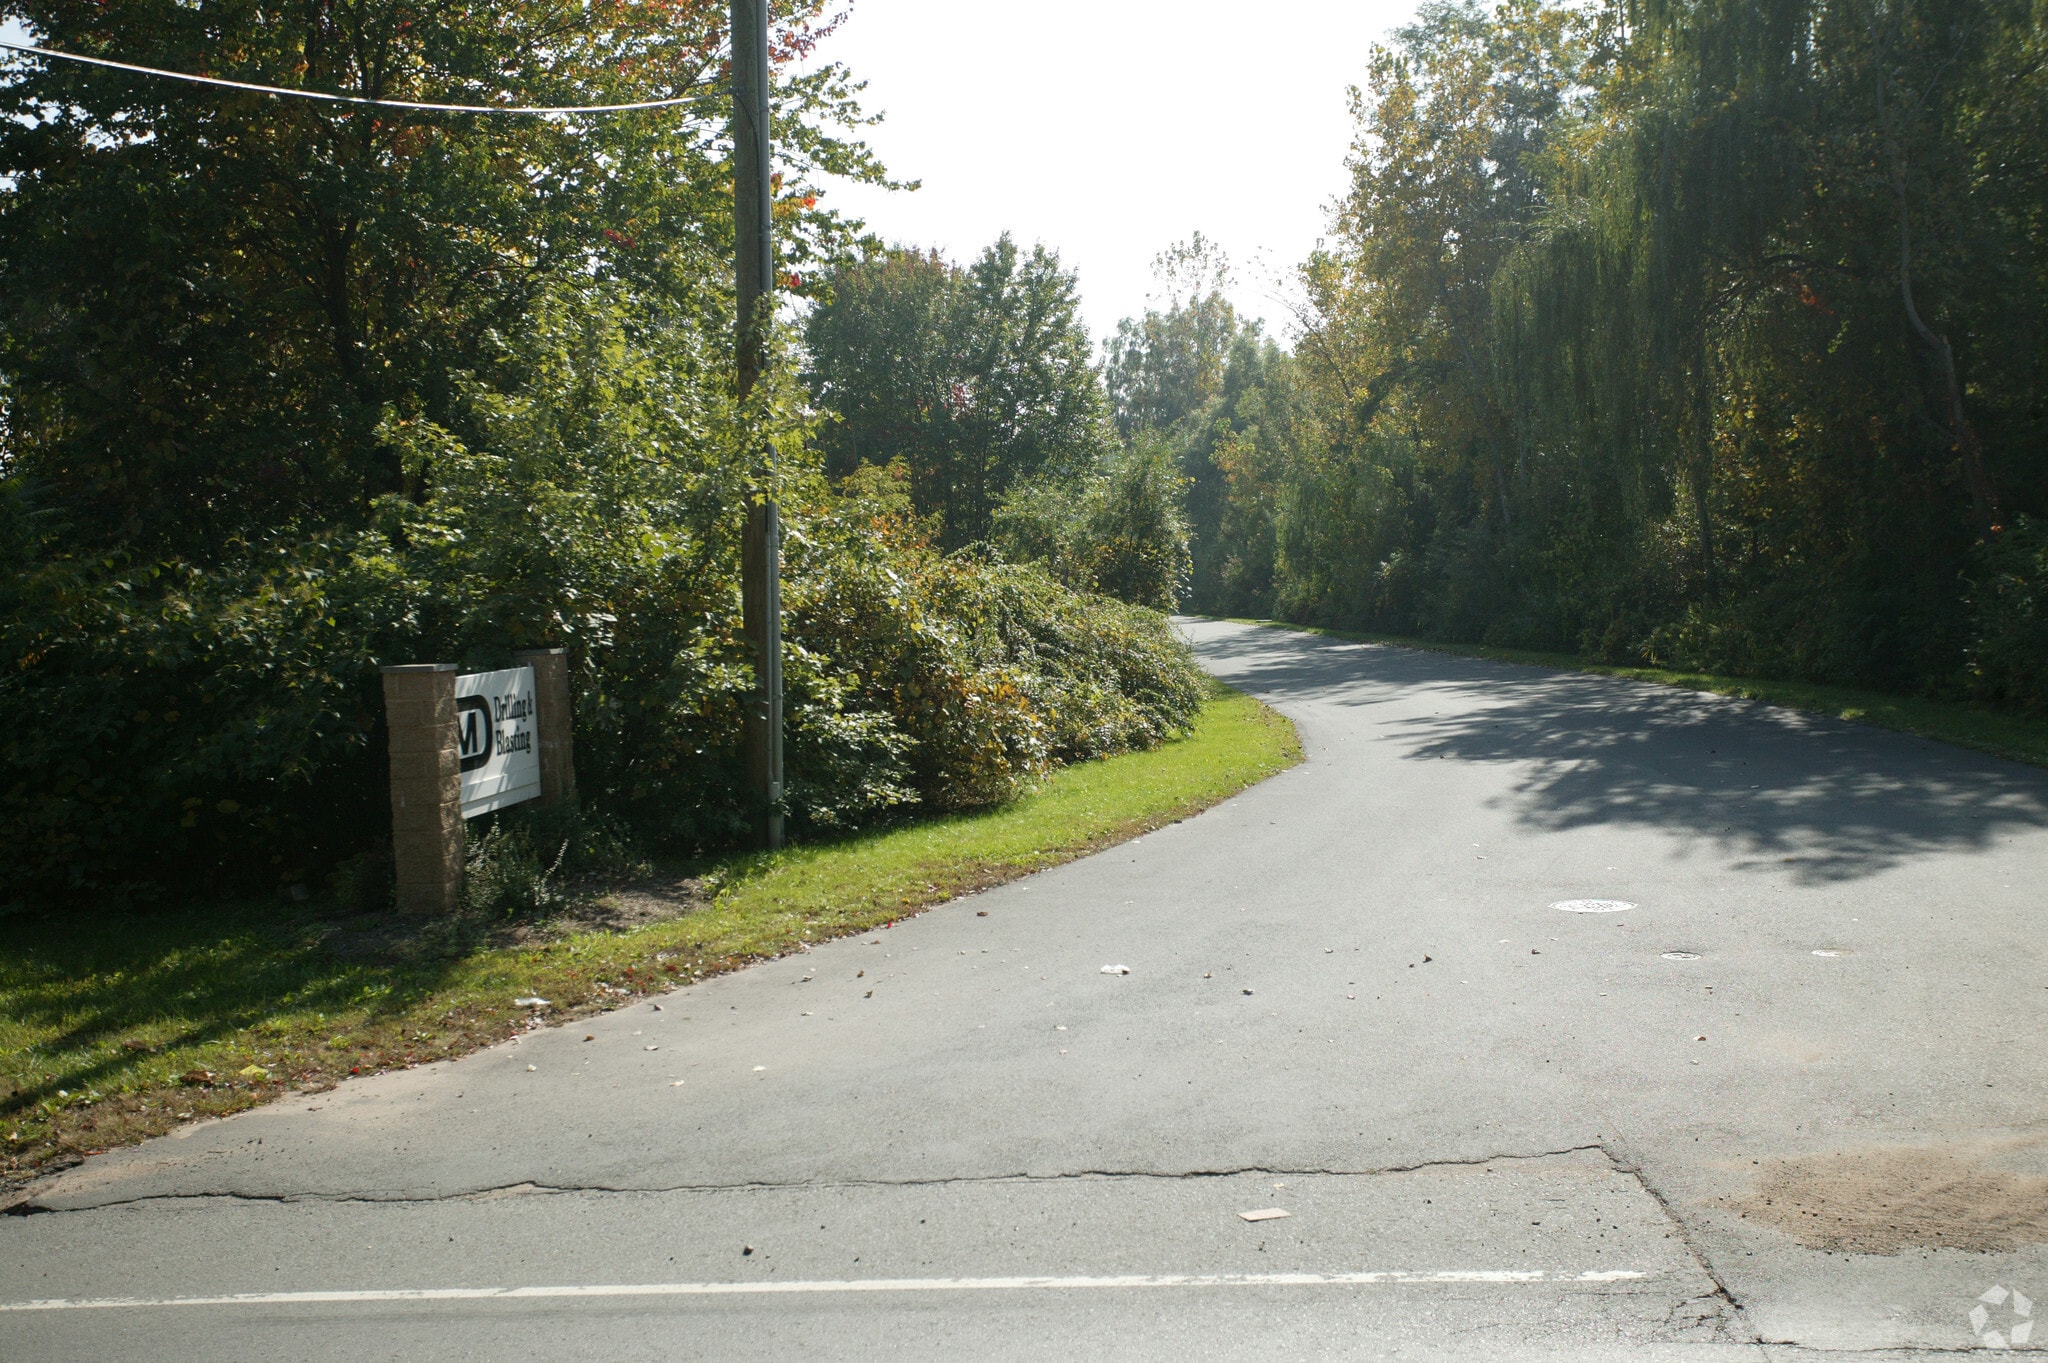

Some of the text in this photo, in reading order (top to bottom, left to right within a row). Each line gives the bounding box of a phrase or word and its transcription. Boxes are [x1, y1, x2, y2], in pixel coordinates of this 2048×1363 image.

[494, 691, 533, 723] Drilling &
[496, 727, 531, 756] Blasting
